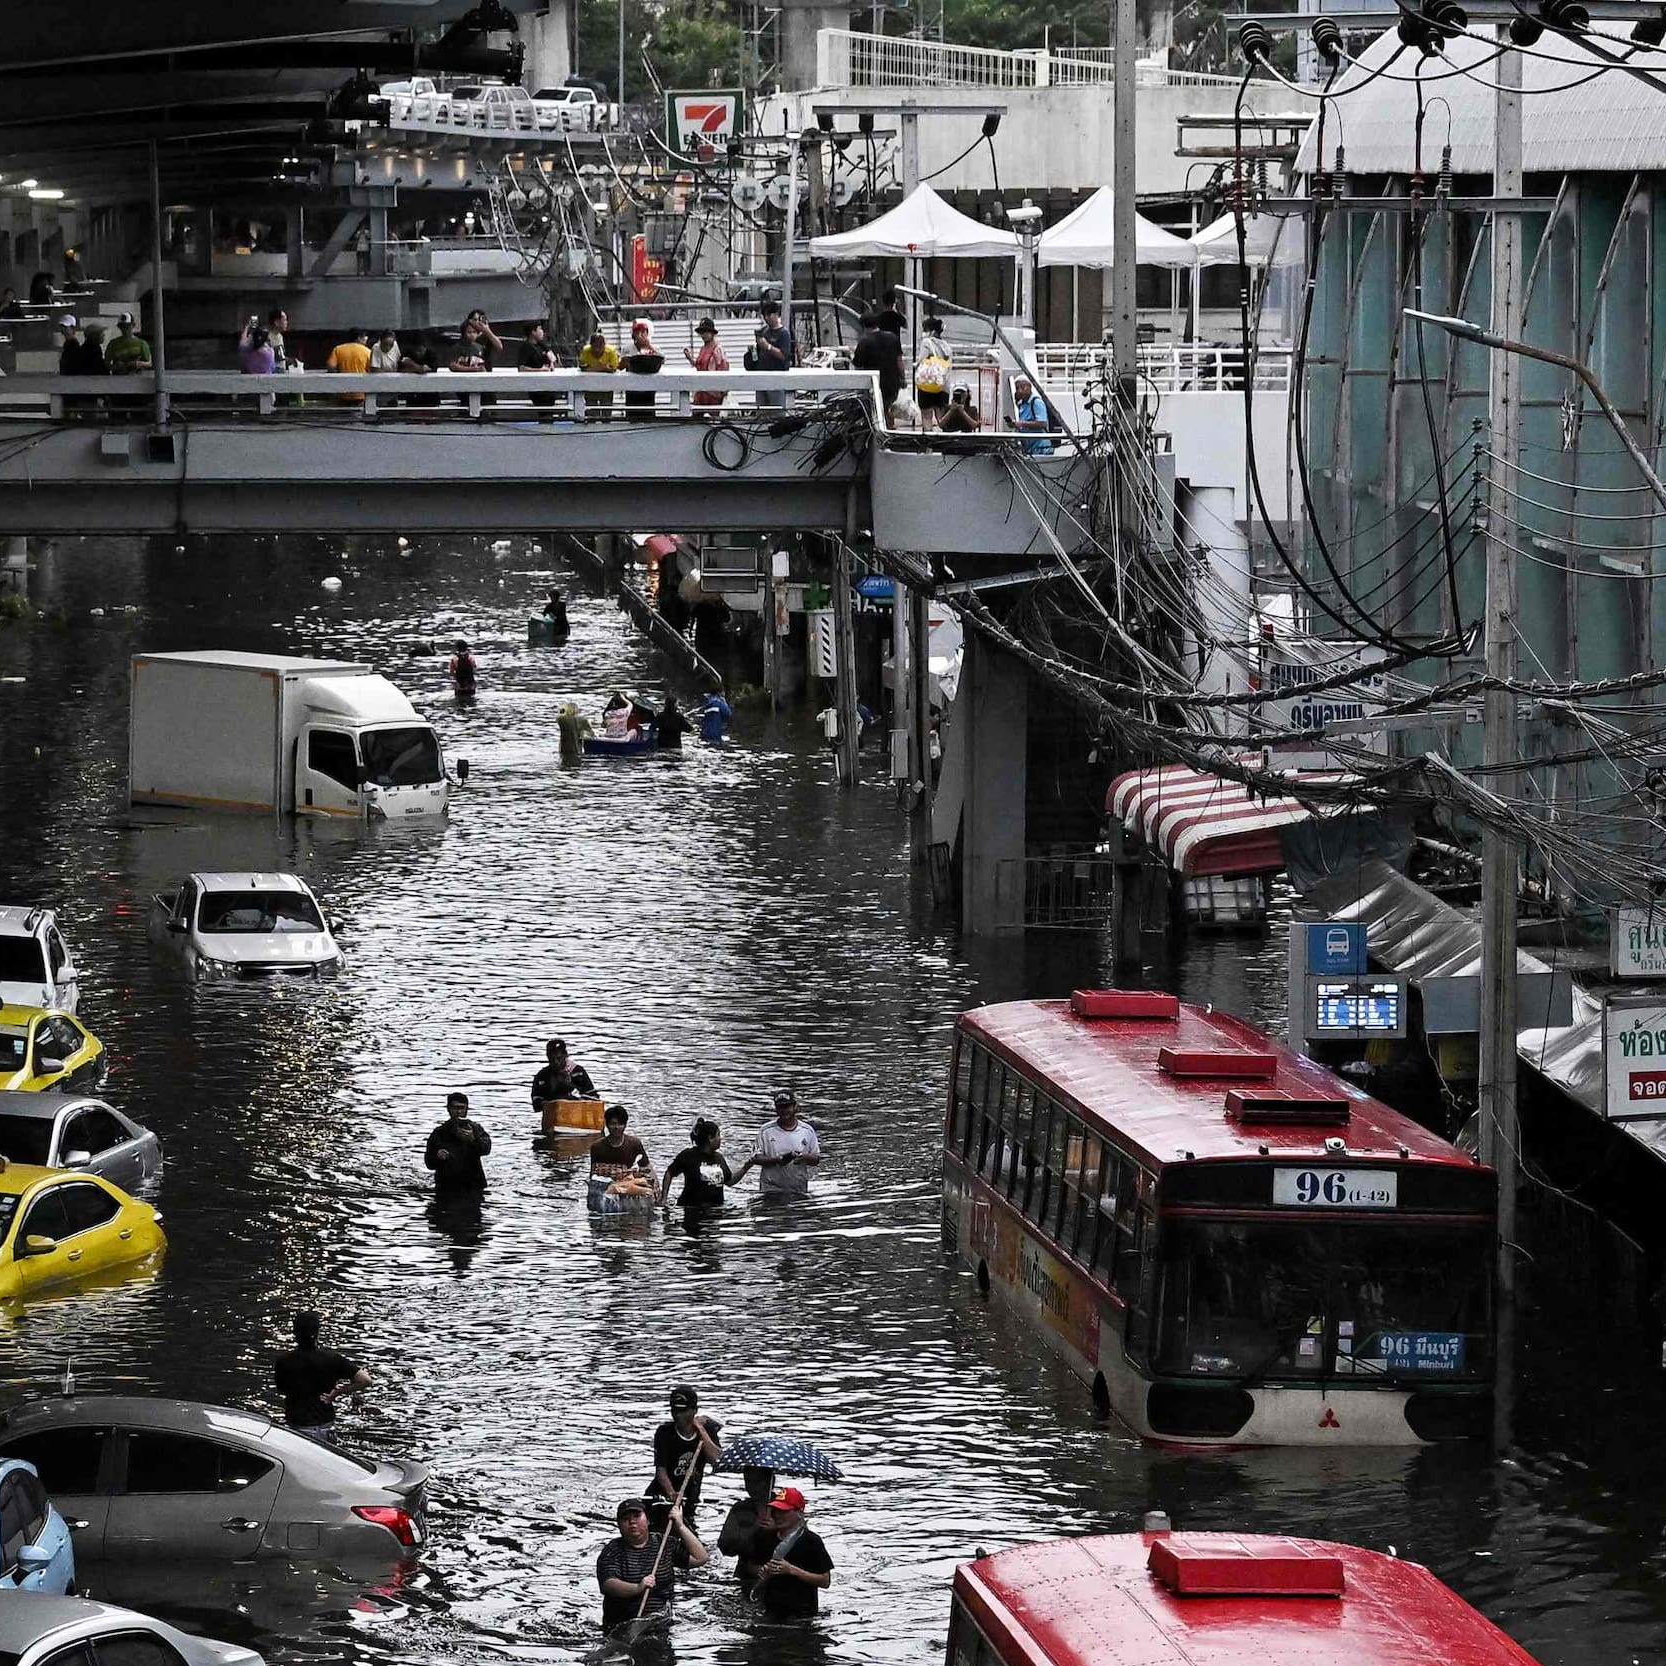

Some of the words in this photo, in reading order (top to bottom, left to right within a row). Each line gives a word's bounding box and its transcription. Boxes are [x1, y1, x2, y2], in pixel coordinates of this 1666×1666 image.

[685, 104, 727, 132] 7
[1296, 1172, 1347, 1203] 96
[1349, 1190, 1390, 1204] (1-42)
[1380, 1336, 1411, 1356] 96
[1414, 1336, 1461, 1361] มีนบุรี
